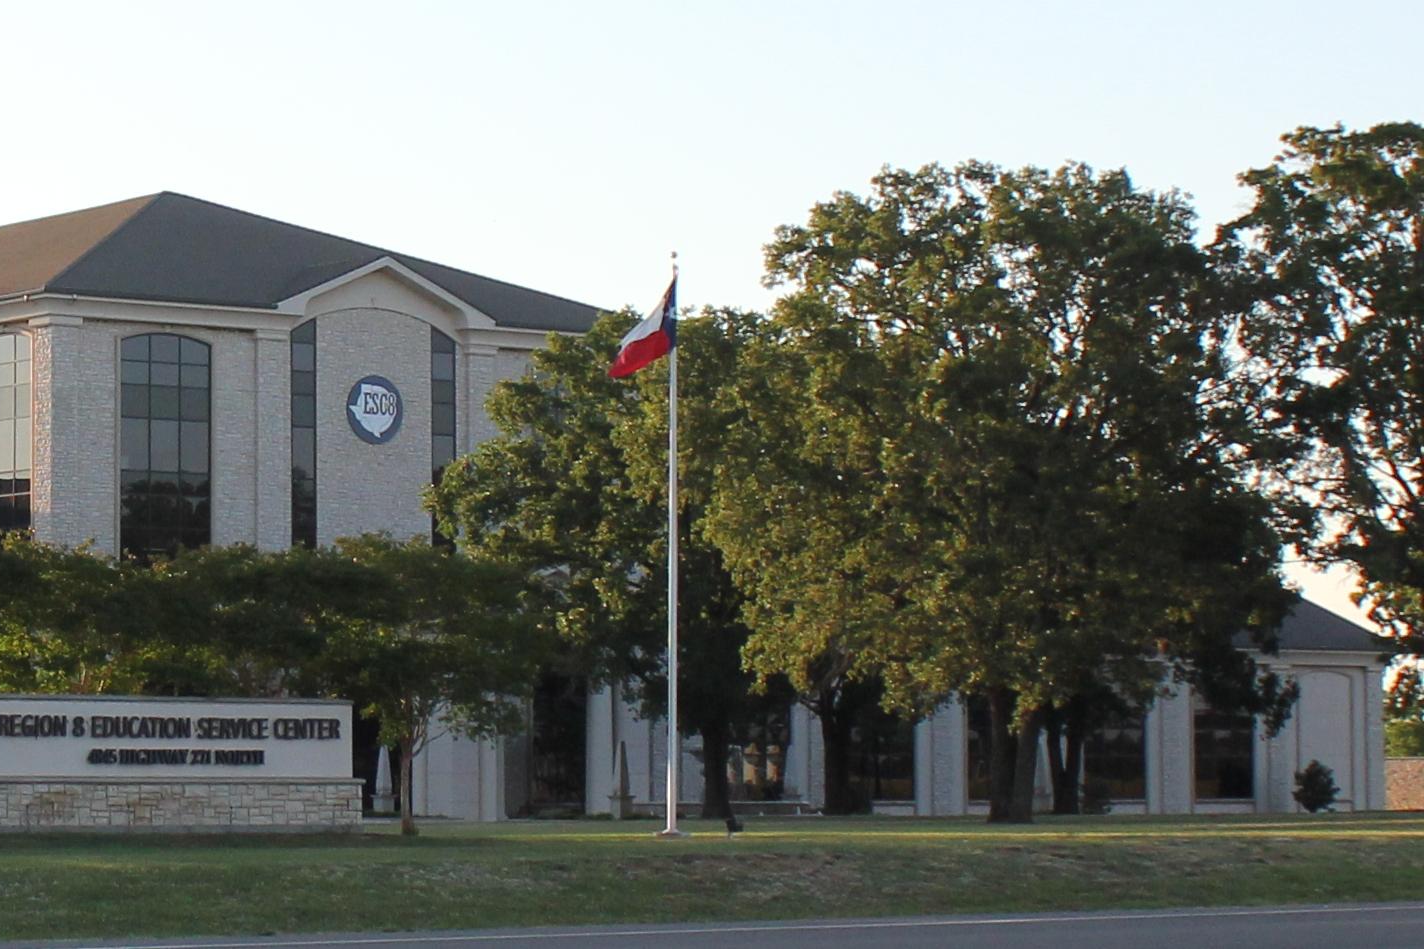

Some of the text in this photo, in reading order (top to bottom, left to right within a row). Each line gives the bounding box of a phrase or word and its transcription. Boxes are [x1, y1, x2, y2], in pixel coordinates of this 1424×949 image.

[363, 392, 396, 415] ESC8
[72, 716, 85, 737] 8
[91, 716, 191, 739] EDUCATION
[197, 717, 269, 740] SERVICE
[273, 718, 341, 741] CENTER
[119, 749, 189, 766] HIGHWAY
